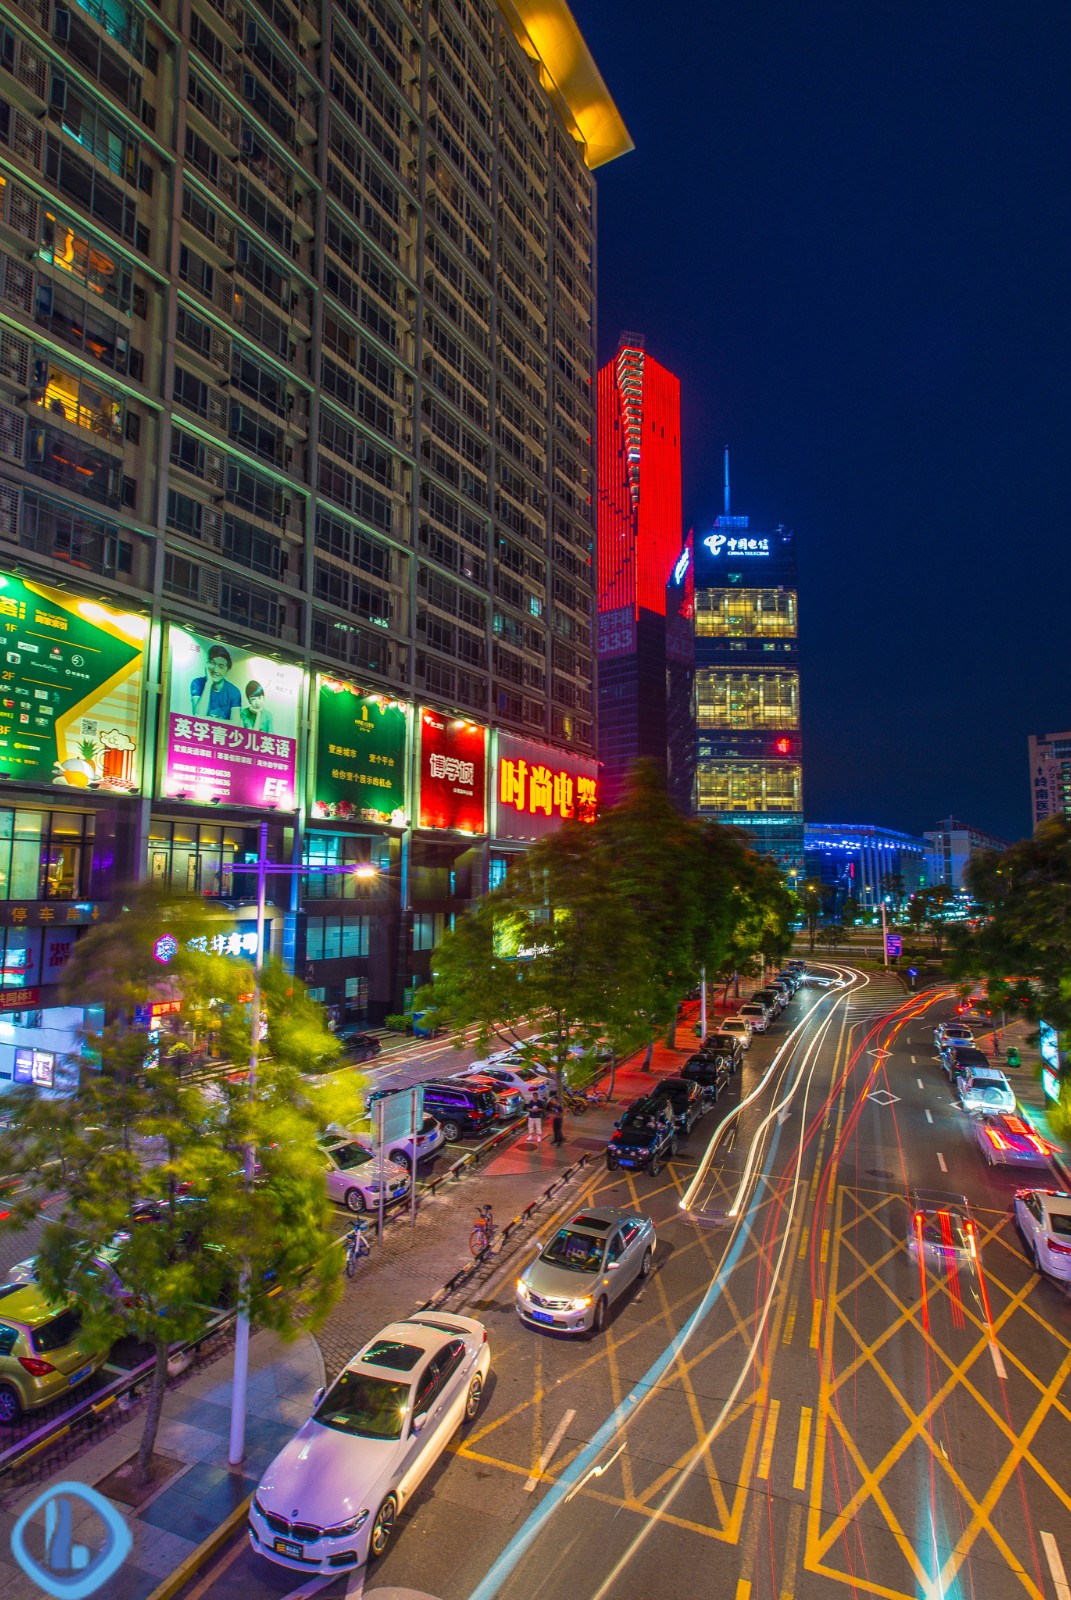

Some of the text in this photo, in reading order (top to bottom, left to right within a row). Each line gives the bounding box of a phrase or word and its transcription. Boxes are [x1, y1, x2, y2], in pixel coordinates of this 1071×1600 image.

[727, 538, 769, 550] 中国电信
[175, 718, 290, 758] 英孚青少儿英语
[369, 754, 394, 767] 壹个平台
[264, 777, 288, 797] EF
